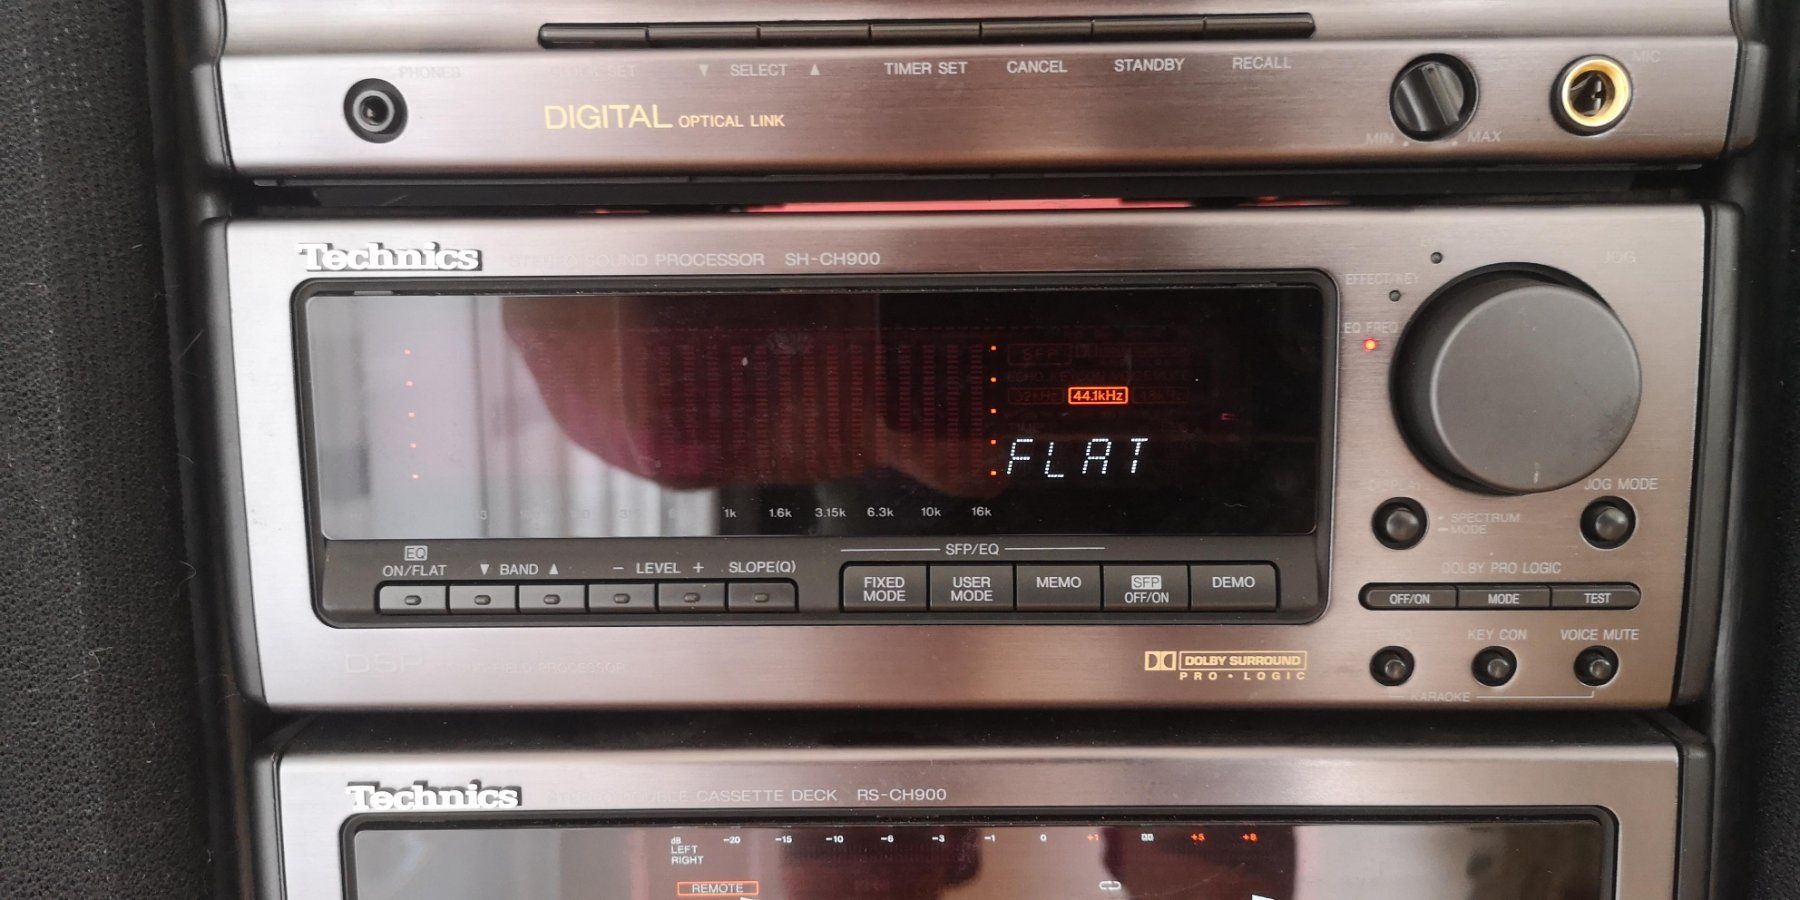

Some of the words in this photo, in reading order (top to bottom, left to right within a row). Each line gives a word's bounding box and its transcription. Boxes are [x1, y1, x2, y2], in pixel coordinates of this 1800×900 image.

[884, 62, 932, 76] TIMER
[938, 61, 968, 75] SET
[1006, 60, 1068, 74] CANCEL
[1113, 57, 1186, 73] STANDBY
[1231, 55, 1292, 71] RECALL
[729, 63, 787, 78] SELECT
[543, 103, 674, 131] DIGITAL
[678, 114, 744, 128] OPTICAL
[750, 113, 785, 128] LINK
[1365, 131, 1395, 147] MIN
[1467, 129, 1502, 144] MAX
[296, 241, 482, 272] Technics
[655, 251, 765, 267] PROCESSOR
[785, 250, 881, 267] SH-CH900
[1343, 322, 1361, 334] EQ
[1073, 388, 1124, 402] 44.1kHz
[1007, 438, 1149, 478] FLAT
[1584, 479, 1612, 491] JOG
[1618, 477, 1659, 490] MODE
[725, 508, 737, 519] 1k
[769, 507, 792, 519] 1.6k
[815, 507, 846, 519] 3.15k
[867, 507, 894, 519] 6.3k
[921, 506, 941, 518] 10k
[971, 506, 992, 518] 16k
[1450, 512, 1521, 524] SPECTRUM
[1450, 524, 1488, 535] MODE
[405, 546, 427, 560] EQ
[944, 542, 1000, 557] SFP/EQ
[382, 564, 448, 578] ON/FLAT
[500, 563, 539, 576] BAND
[635, 562, 681, 575] LEVEL
[728, 560, 796, 575] SLOPE(Q)
[1490, 561, 1518, 574] PRO
[1522, 561, 1562, 574] LOGIC
[863, 576, 905, 589] FIXED
[952, 576, 991, 589] USER
[1036, 576, 1082, 589] MEMO
[1132, 575, 1161, 588] SFP
[1211, 575, 1255, 588] DEMO
[863, 589, 906, 602] MODE
[950, 589, 993, 602] MODE
[1124, 591, 1169, 604] OFF/ON
[1389, 593, 1430, 605] OFF/ON
[1488, 593, 1520, 605] MODE
[1584, 592, 1611, 604] TEST
[1467, 629, 1494, 641] KEY
[1498, 628, 1527, 641] CON
[1560, 629, 1598, 641] VOICE
[1602, 629, 1640, 641] MUTE
[1184, 655, 1226, 667] DOLBY
[1229, 655, 1301, 667] SURROUND
[1179, 672, 1218, 681] PRO
[1243, 671, 1306, 681] LOGIC
[1409, 691, 1470, 703] KARAOKE
[345, 779, 522, 811] Technics
[697, 789, 784, 803] CASSETTE
[792, 788, 838, 802] DECK
[856, 788, 947, 802] RS-CH900
[723, 836, 741, 844] -20
[984, 834, 996, 842] -1
[1040, 834, 1047, 842] 0
[671, 845, 698, 854] LEFT
[671, 855, 704, 865] RIGHT
[692, 883, 744, 894] REMOTE
